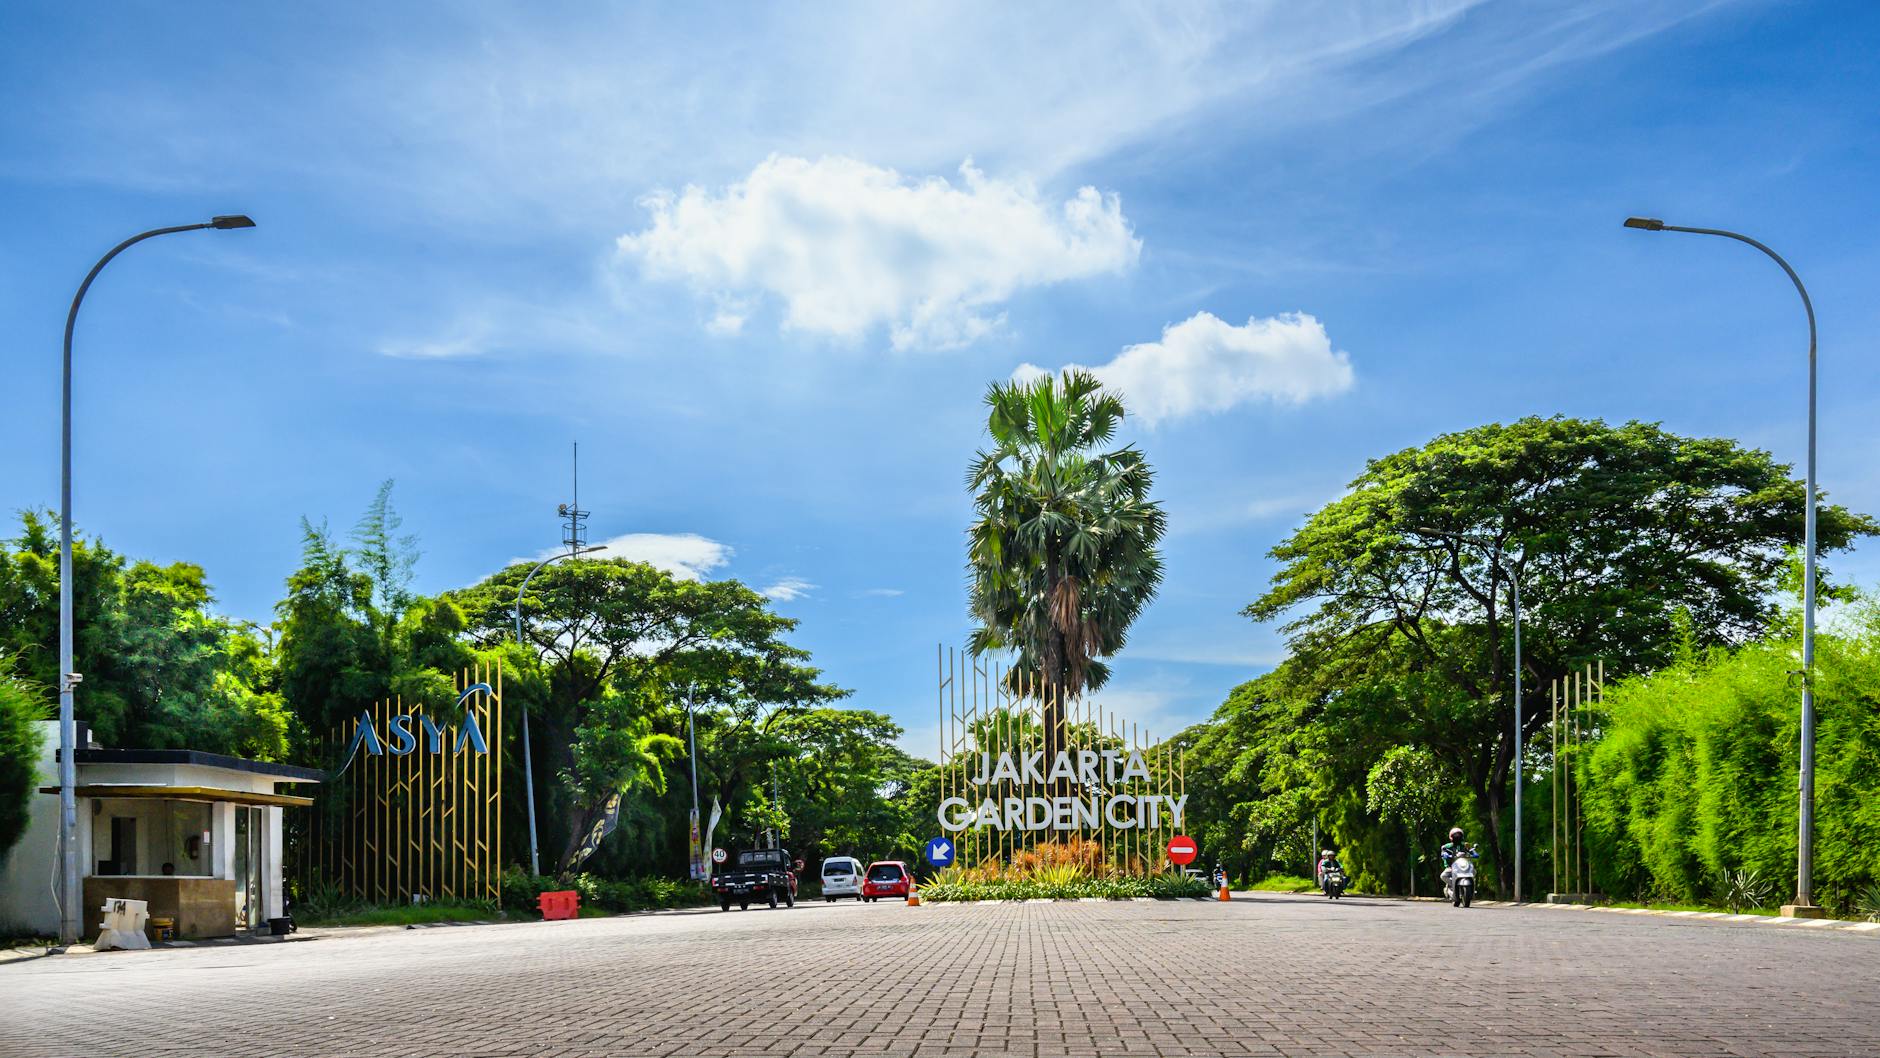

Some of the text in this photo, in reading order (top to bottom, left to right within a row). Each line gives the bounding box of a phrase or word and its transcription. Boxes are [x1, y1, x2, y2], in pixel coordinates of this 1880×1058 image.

[337, 708, 489, 777] ASYA
[971, 750, 1152, 785] JAKARTA
[937, 794, 1189, 831] GARDEN CITY
[714, 850, 725, 858] 40
